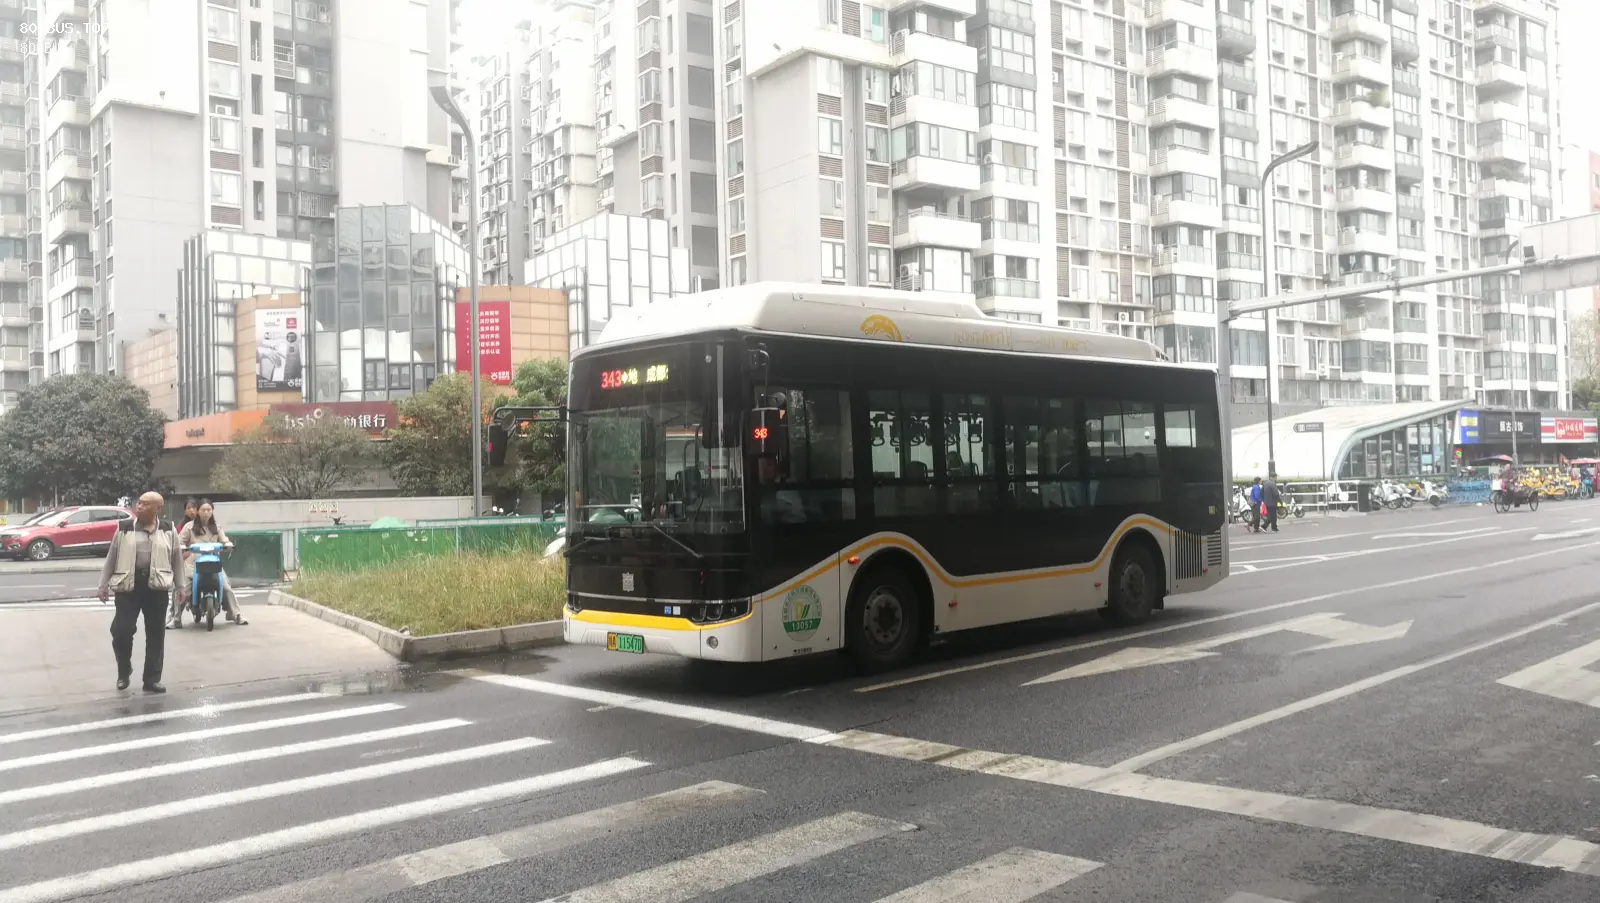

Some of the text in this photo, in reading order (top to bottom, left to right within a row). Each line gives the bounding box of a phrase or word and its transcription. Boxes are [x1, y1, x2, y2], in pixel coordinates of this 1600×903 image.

[601, 370, 622, 388] 343
[344, 413, 387, 428] 商银行
[754, 428, 768, 439] 343
[792, 620, 813, 631] 13057
